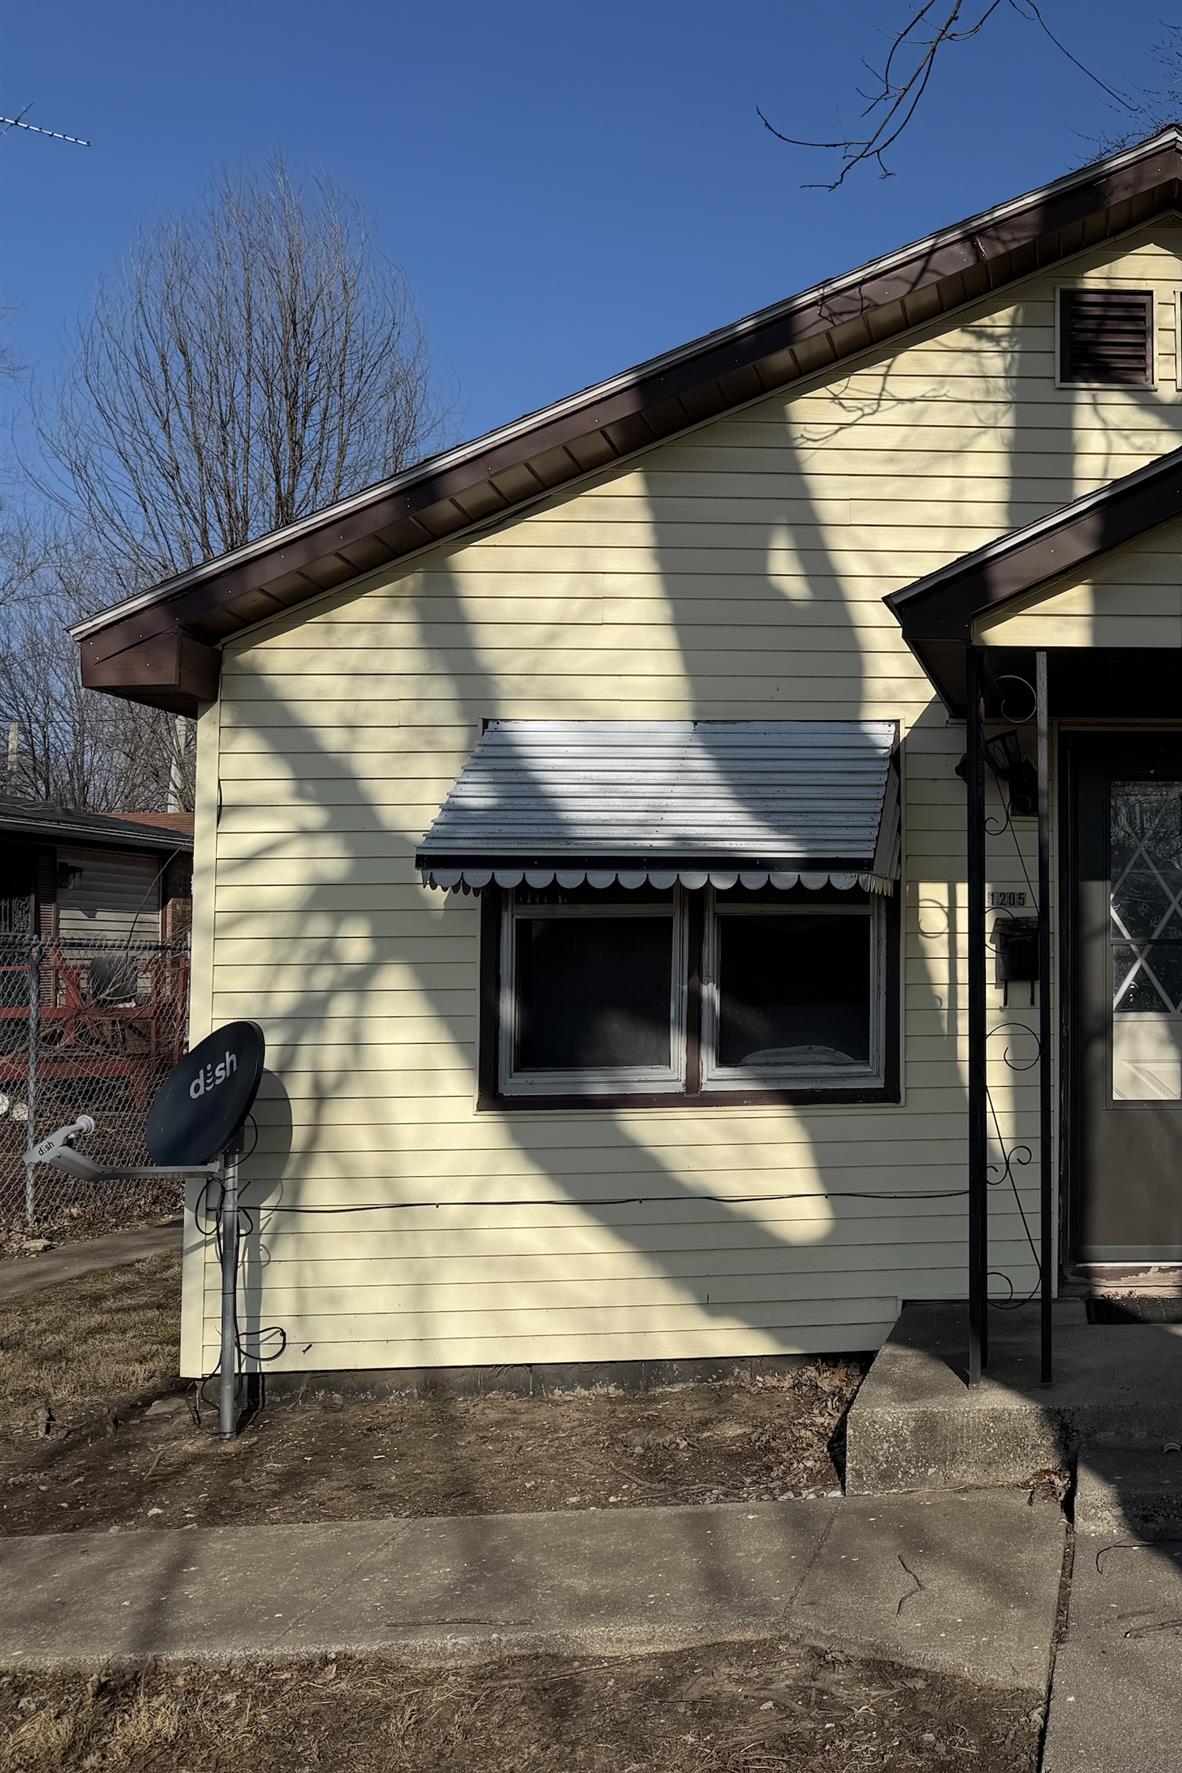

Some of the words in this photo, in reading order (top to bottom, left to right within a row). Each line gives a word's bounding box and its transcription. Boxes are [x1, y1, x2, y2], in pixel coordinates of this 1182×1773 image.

[990, 892, 1026, 906] 1205
[189, 1050, 237, 1099] dish
[38, 1140, 55, 1156] dish
